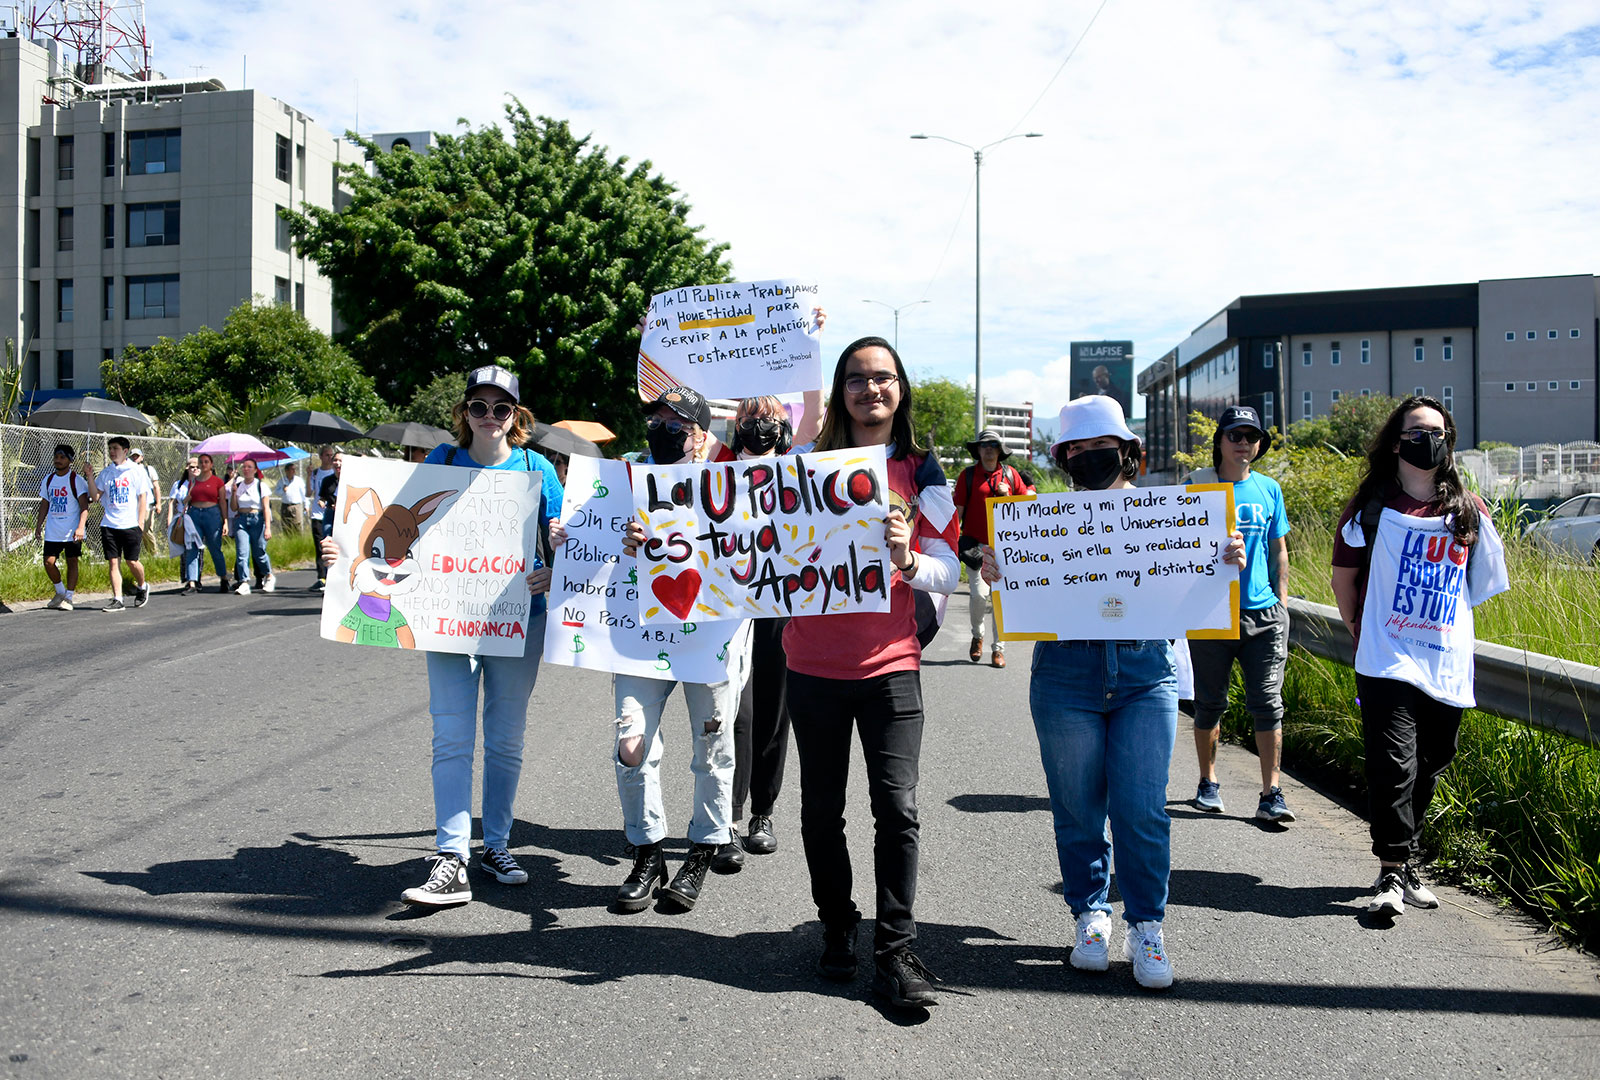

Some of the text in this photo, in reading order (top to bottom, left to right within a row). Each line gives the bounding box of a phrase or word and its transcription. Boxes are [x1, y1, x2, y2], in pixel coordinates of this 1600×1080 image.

[1090, 346, 1123, 356] LAFISE
[1235, 410, 1253, 419] UCR
[468, 469, 512, 495] DE
[646, 454, 883, 524] La U Pública
[446, 496, 519, 520] TANTO
[566, 504, 602, 530] Sin
[1083, 503, 1093, 525] y
[1099, 498, 1115, 512] mi
[1123, 491, 1167, 512] Padre
[1177, 495, 1201, 505] son
[428, 519, 519, 537] AHORRAR
[996, 510, 1209, 543] resultado de la Universidad
[464, 537, 485, 551] EN
[565, 537, 620, 564] Pública
[644, 519, 782, 586] es tuya
[1002, 537, 1219, 566] Pública, sin ella su realidad y
[1401, 530, 1448, 563] LA U
[431, 553, 526, 575] EDUCACIÓN
[1397, 555, 1464, 598] PÚBLICA
[423, 577, 509, 598] NOS HEMOS
[563, 575, 617, 598] habrá
[748, 540, 888, 616] Apóyala
[1004, 576, 1020, 591] la
[1025, 573, 1050, 587] mía
[1063, 572, 1108, 586] serían
[1115, 569, 1141, 587] muy
[403, 597, 528, 617] HECHO MILLONARIOS
[1392, 583, 1458, 626] ES TUYA
[362, 624, 394, 644] FEES
[413, 615, 525, 640] EN IGNORANCIA
[1415, 639, 1428, 648] TEC
